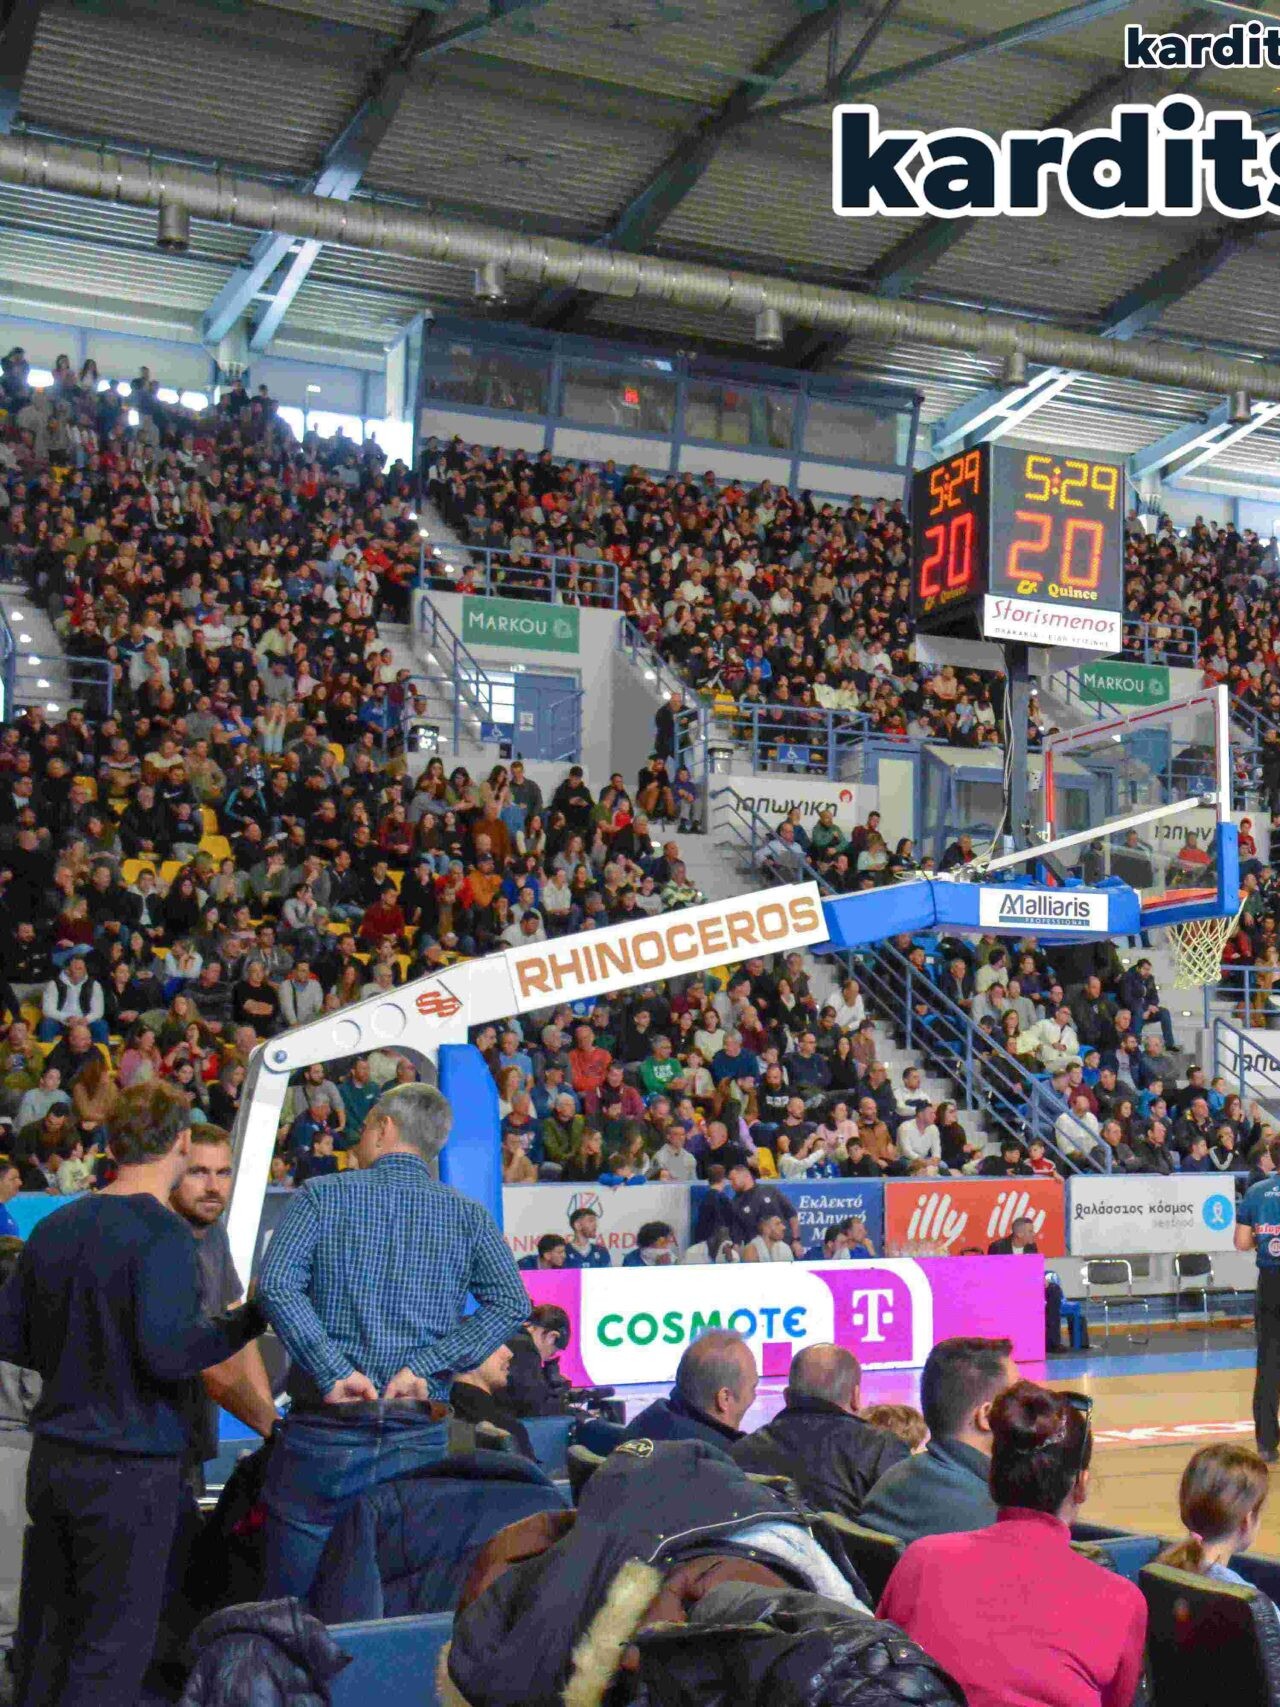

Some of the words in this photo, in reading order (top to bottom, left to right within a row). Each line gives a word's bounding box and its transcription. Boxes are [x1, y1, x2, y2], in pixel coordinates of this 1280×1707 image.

[1024, 454, 1119, 510] 5:29
[919, 511, 974, 598] 20
[1008, 509, 1104, 588] 20
[1047, 583, 1098, 600] Quince
[469, 611, 548, 635] MARKOU
[992, 599, 1116, 633] Storismenos
[1084, 672, 1145, 694] MARKOU
[1000, 893, 1090, 917] Malliaris
[1025, 917, 1087, 926] PROFESSIONAL
[515, 898, 820, 998] RHINOCEROS
[799, 1194, 863, 1209] Εκλεκτό
[1149, 1200, 1193, 1214] κόσμος
[907, 1192, 968, 1248] illy
[987, 1190, 1046, 1238] illy
[596, 1306, 808, 1347] COSMOTE
